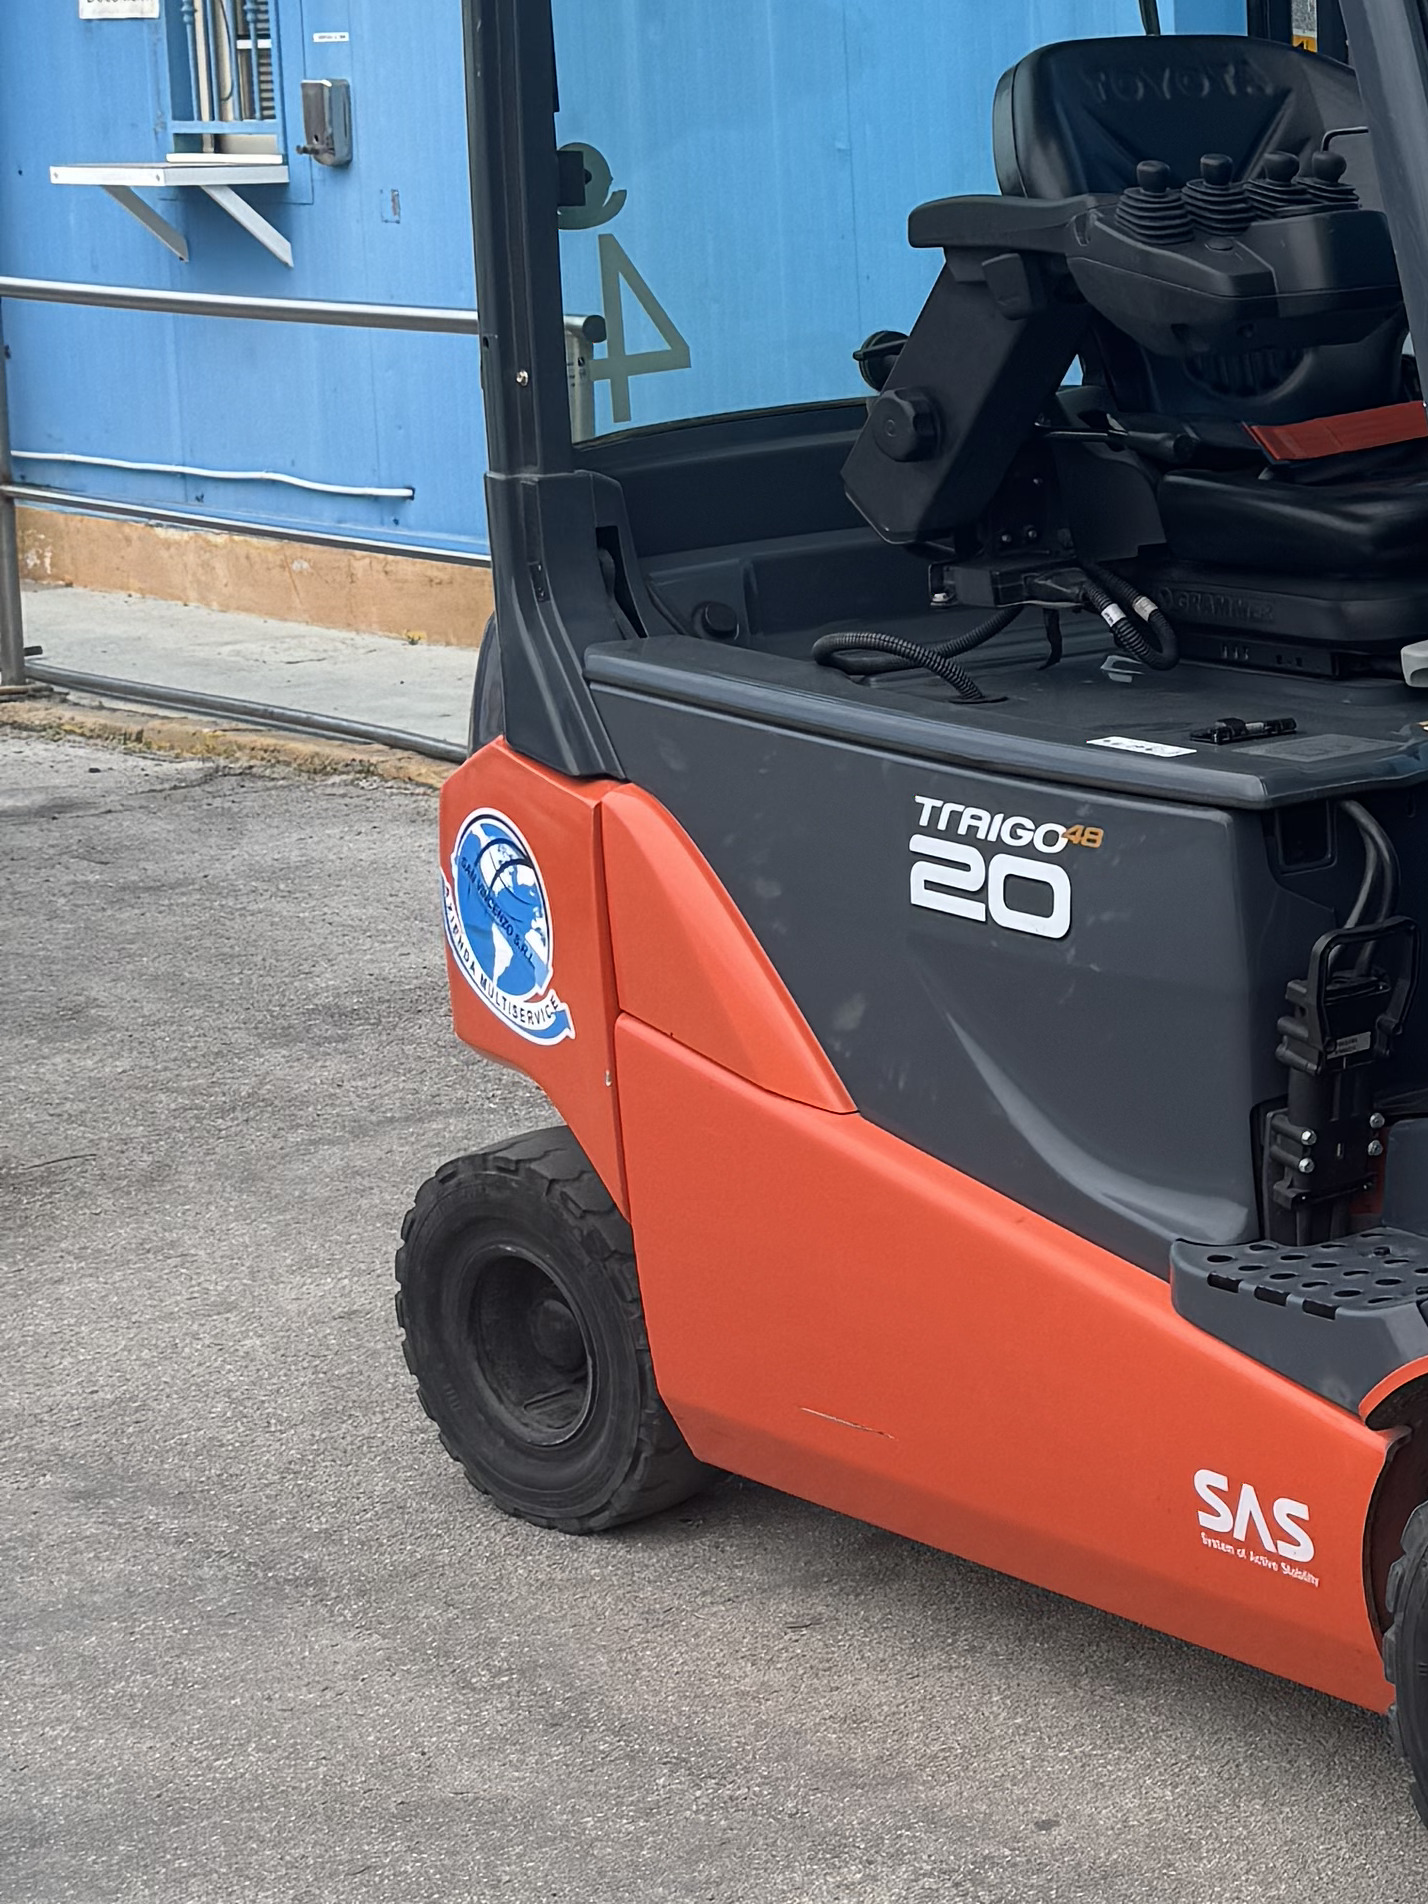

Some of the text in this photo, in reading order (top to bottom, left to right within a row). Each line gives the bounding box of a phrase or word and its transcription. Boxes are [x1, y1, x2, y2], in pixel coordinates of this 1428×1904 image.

[914, 795, 1104, 853] TRAIGO 48
[461, 857, 477, 884] SAN
[909, 834, 1071, 939] 20
[480, 973, 559, 1026] MULTISERVICE
[1193, 1469, 1315, 1563] SAS
